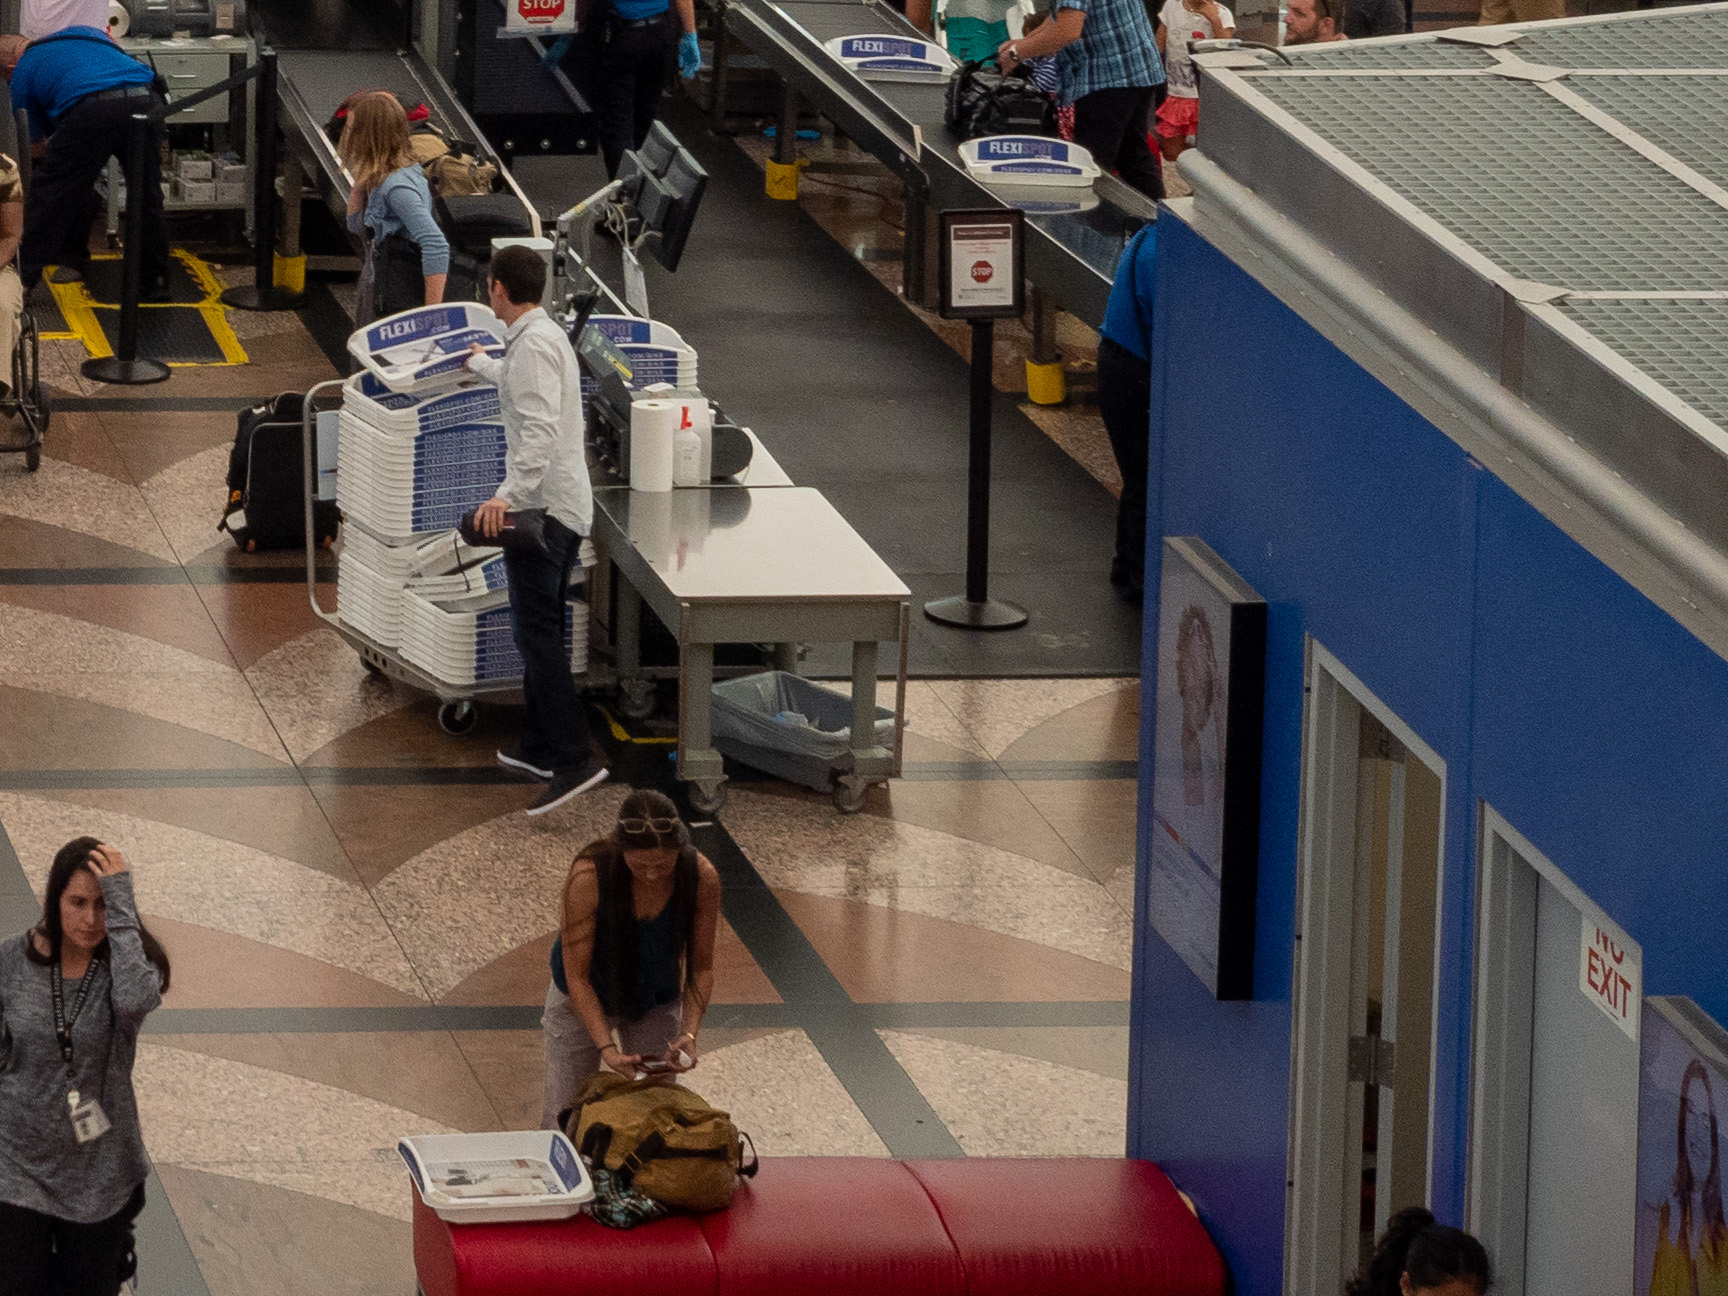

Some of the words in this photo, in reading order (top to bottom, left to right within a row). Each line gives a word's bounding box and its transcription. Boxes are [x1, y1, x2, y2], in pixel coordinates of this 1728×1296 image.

[851, 40, 913, 53] FLEXISPOT
[989, 141, 1054, 155] FLEXISPOT
[972, 267, 992, 277] STOP
[379, 310, 450, 341] FLEXISPOT
[1587, 946, 1632, 1019] EXIT
